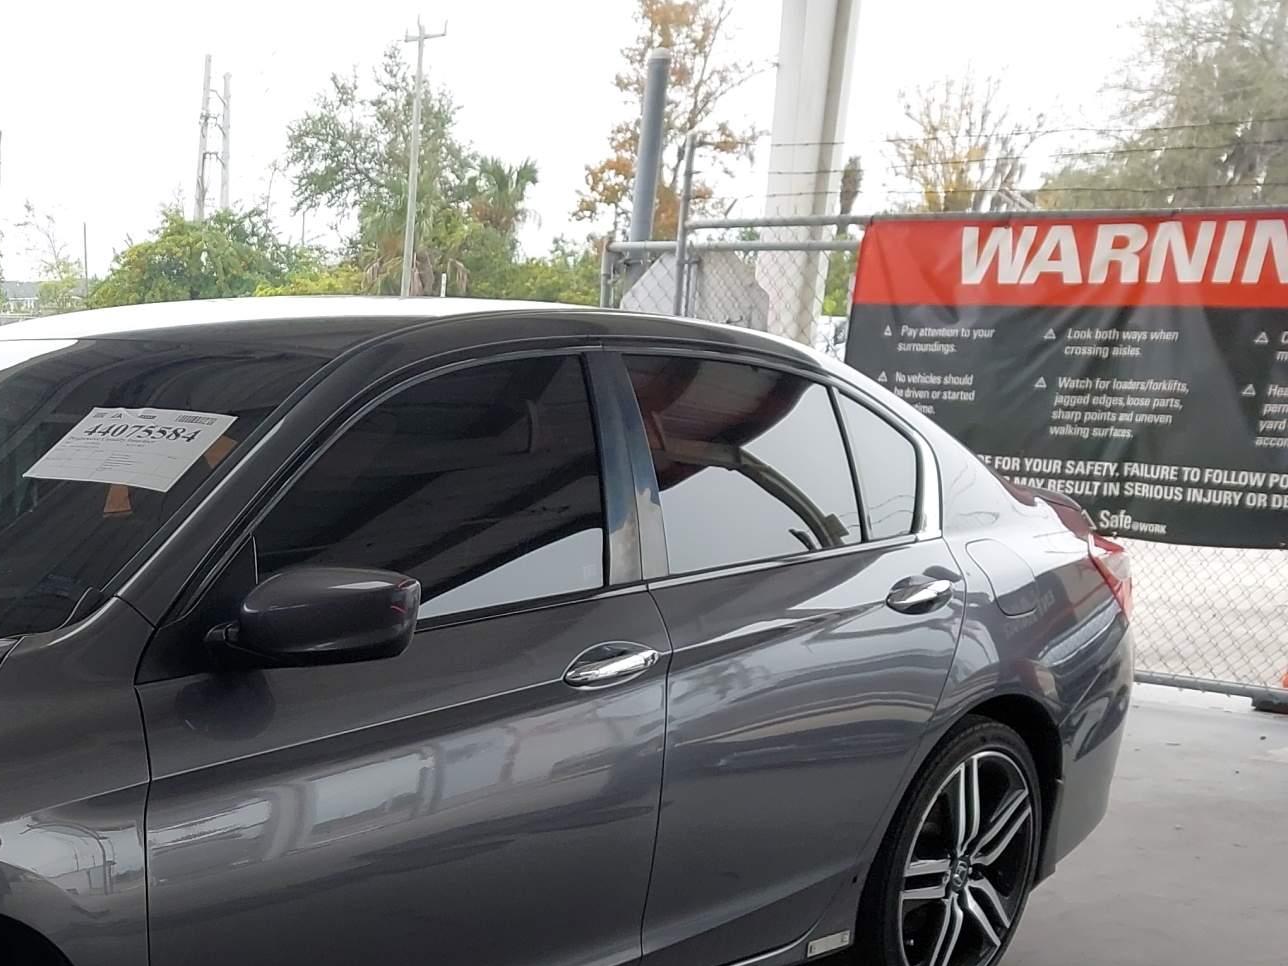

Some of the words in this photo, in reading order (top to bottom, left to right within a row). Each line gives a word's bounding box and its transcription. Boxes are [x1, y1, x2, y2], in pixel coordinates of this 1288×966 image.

[961, 220, 1288, 285] WARNIN
[901, 325, 918, 339] Pay
[919, 327, 959, 337] attention
[961, 328, 970, 337] to
[973, 328, 995, 339] your
[1067, 328, 1092, 340] Look
[1095, 328, 1120, 340] both
[1122, 331, 1147, 342] ways
[1150, 329, 1179, 341] when
[1064, 344, 1109, 358] crossing
[895, 371, 906, 383] No
[907, 372, 942, 384] vehicles
[943, 373, 973, 385] should
[1057, 376, 1093, 389] Watch
[1095, 377, 1112, 389] for
[905, 387, 930, 399] driven
[932, 391, 940, 399] or
[942, 390, 975, 401] started
[1053, 392, 1090, 406] jagged
[1092, 394, 1126, 408] edges,
[1152, 397, 1184, 410] parts,
[1052, 408, 1082, 421] sharp
[1083, 410, 1116, 423] points
[1135, 413, 1173, 424] uneven
[1049, 424, 1090, 439] walking
[1259, 419, 1287, 432] yard
[83, 423, 202, 443] 44075584
[995, 456, 1021, 471] FOR
[1024, 457, 1062, 473] YOUR
[1123, 462, 1178, 481] FAILURE
[1182, 466, 1200, 482] TO
[1204, 468, 1266, 488] FOLLOW
[1048, 479, 1100, 496] RESULT
[1103, 482, 1121, 496] IN
[1124, 481, 1183, 500] SERIOUS
[1187, 487, 1243, 507] INJURY
[1246, 492, 1267, 508] OR
